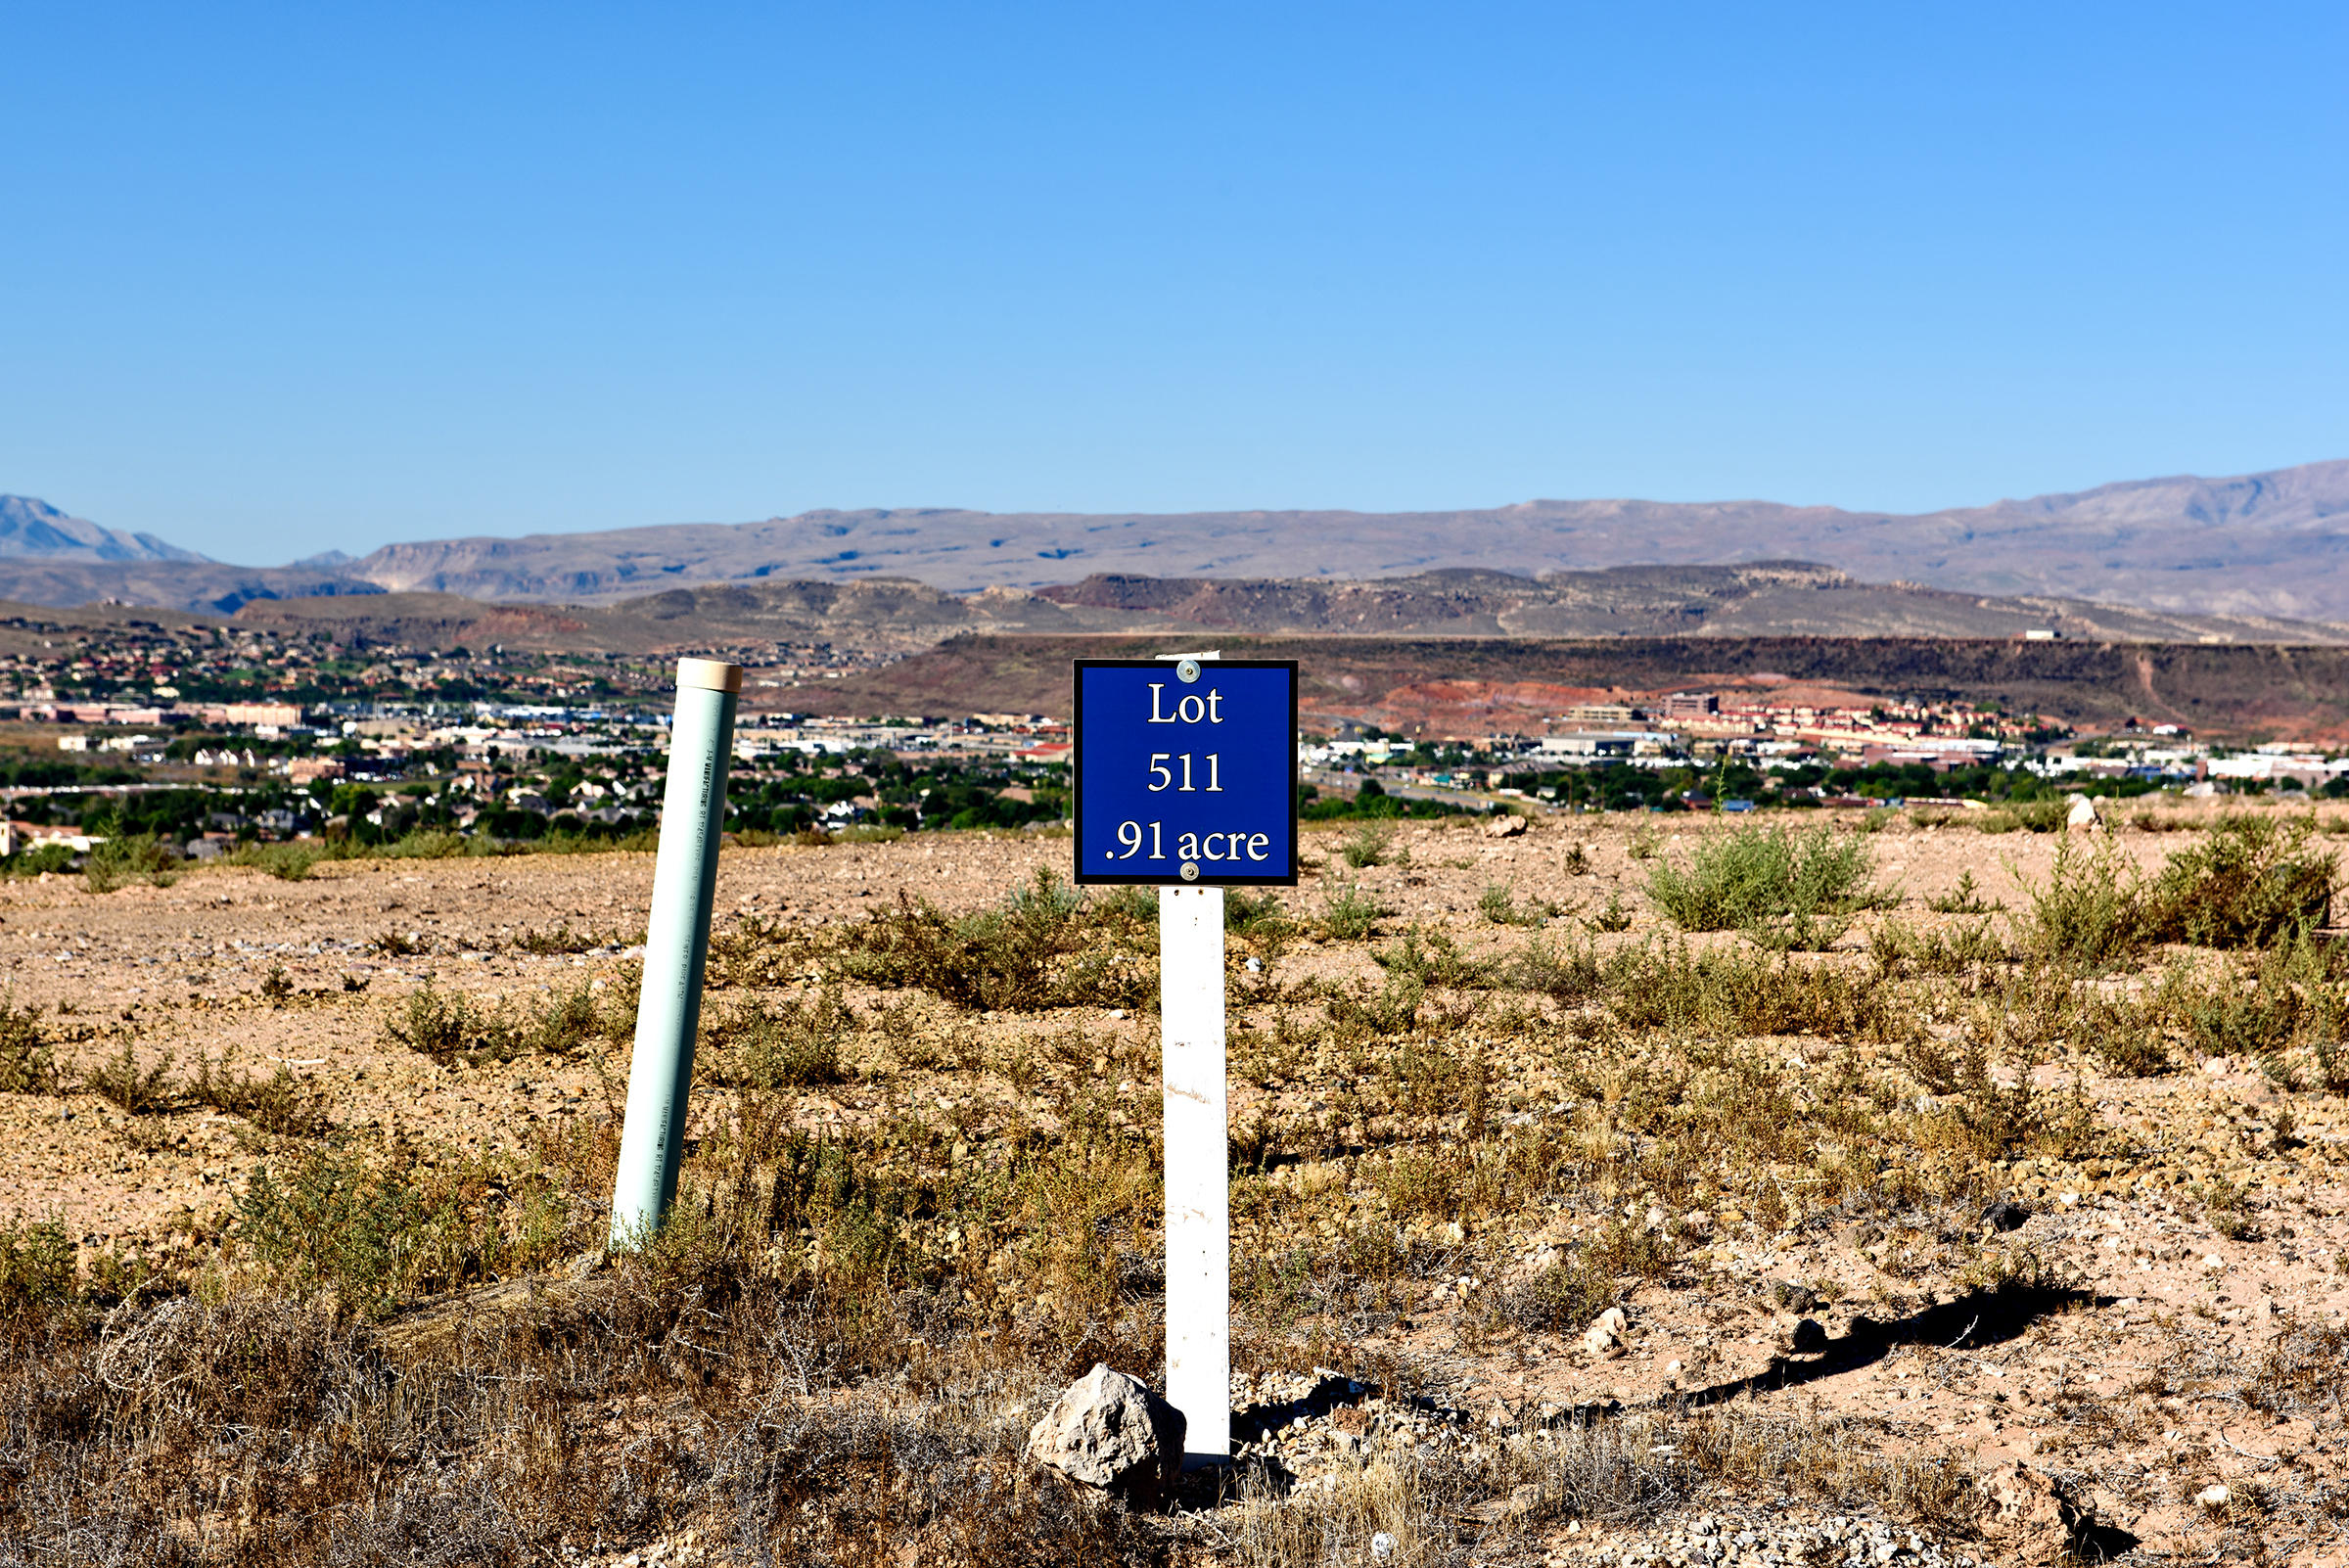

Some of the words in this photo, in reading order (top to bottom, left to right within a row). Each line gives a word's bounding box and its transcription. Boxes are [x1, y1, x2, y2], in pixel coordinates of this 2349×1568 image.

[1147, 683, 1223, 724] Lot
[1147, 753, 1223, 792] 511
[1105, 820, 1167, 859] .91
[1177, 832, 1269, 861] acre
